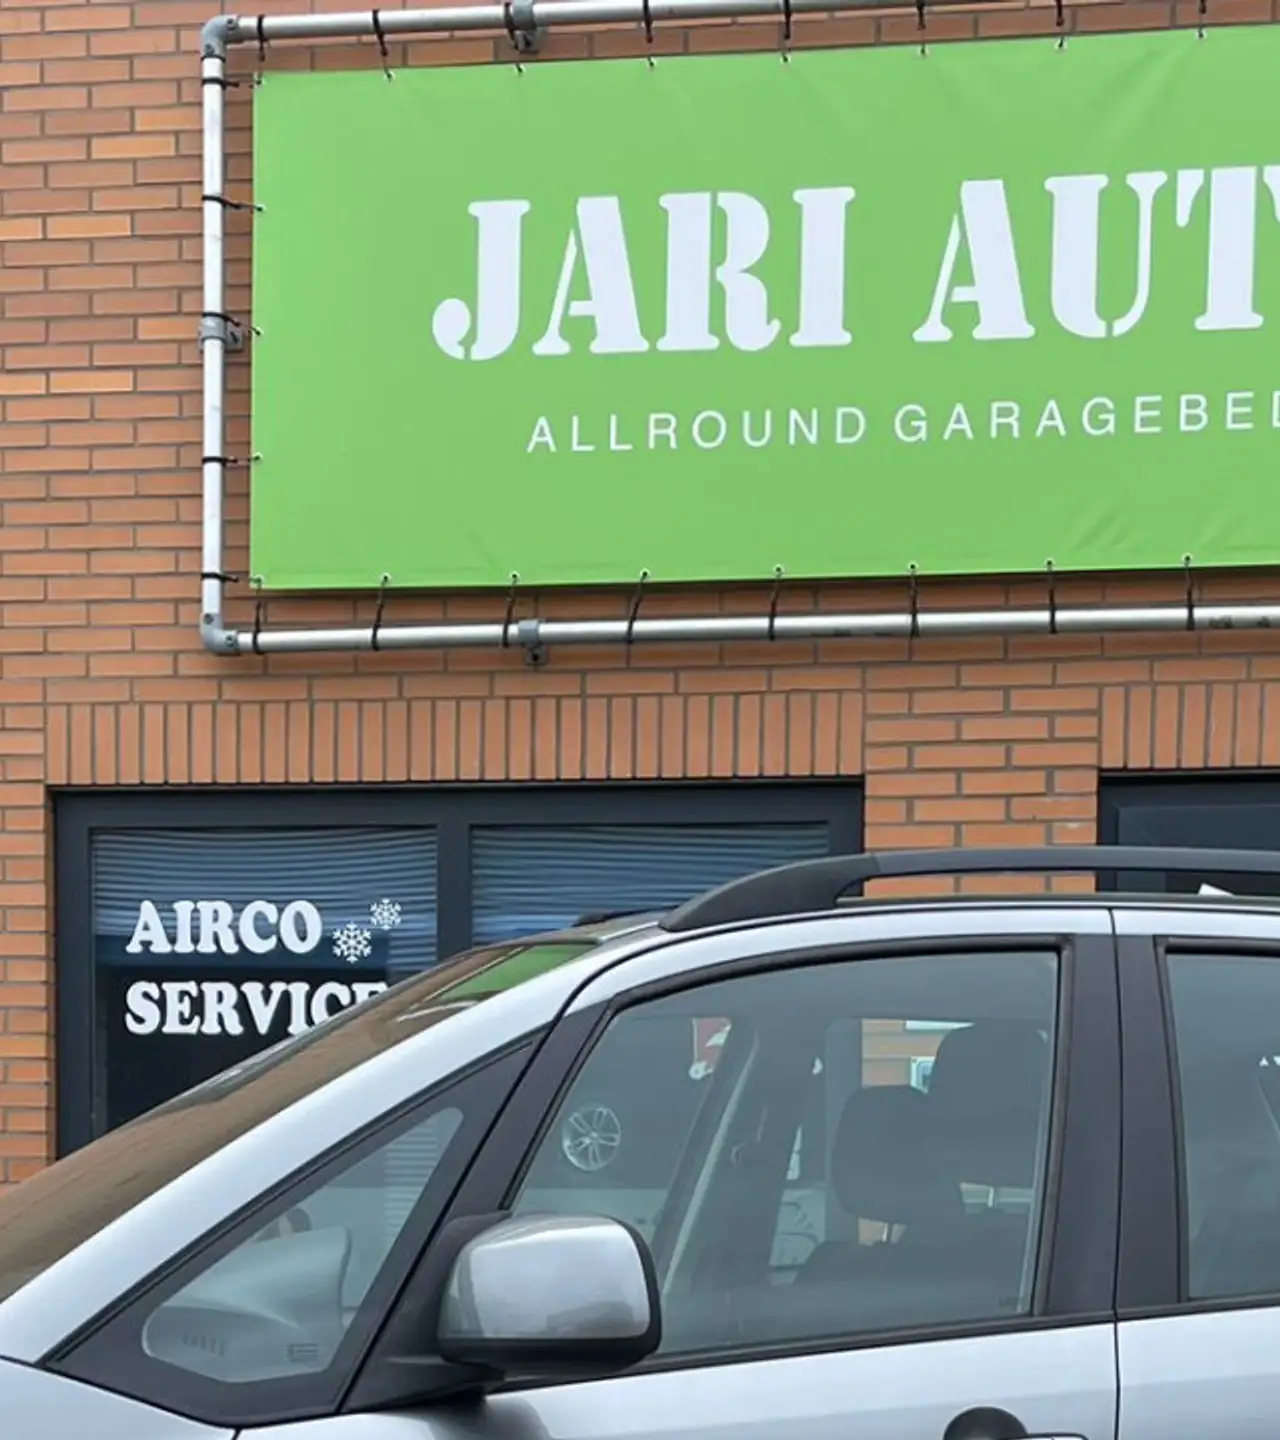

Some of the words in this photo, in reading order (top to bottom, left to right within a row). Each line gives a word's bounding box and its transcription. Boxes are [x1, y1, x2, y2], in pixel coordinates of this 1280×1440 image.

[431, 186, 856, 361] JARI
[526, 403, 867, 454] ALLROUND
[125, 900, 323, 954] AIRCO
